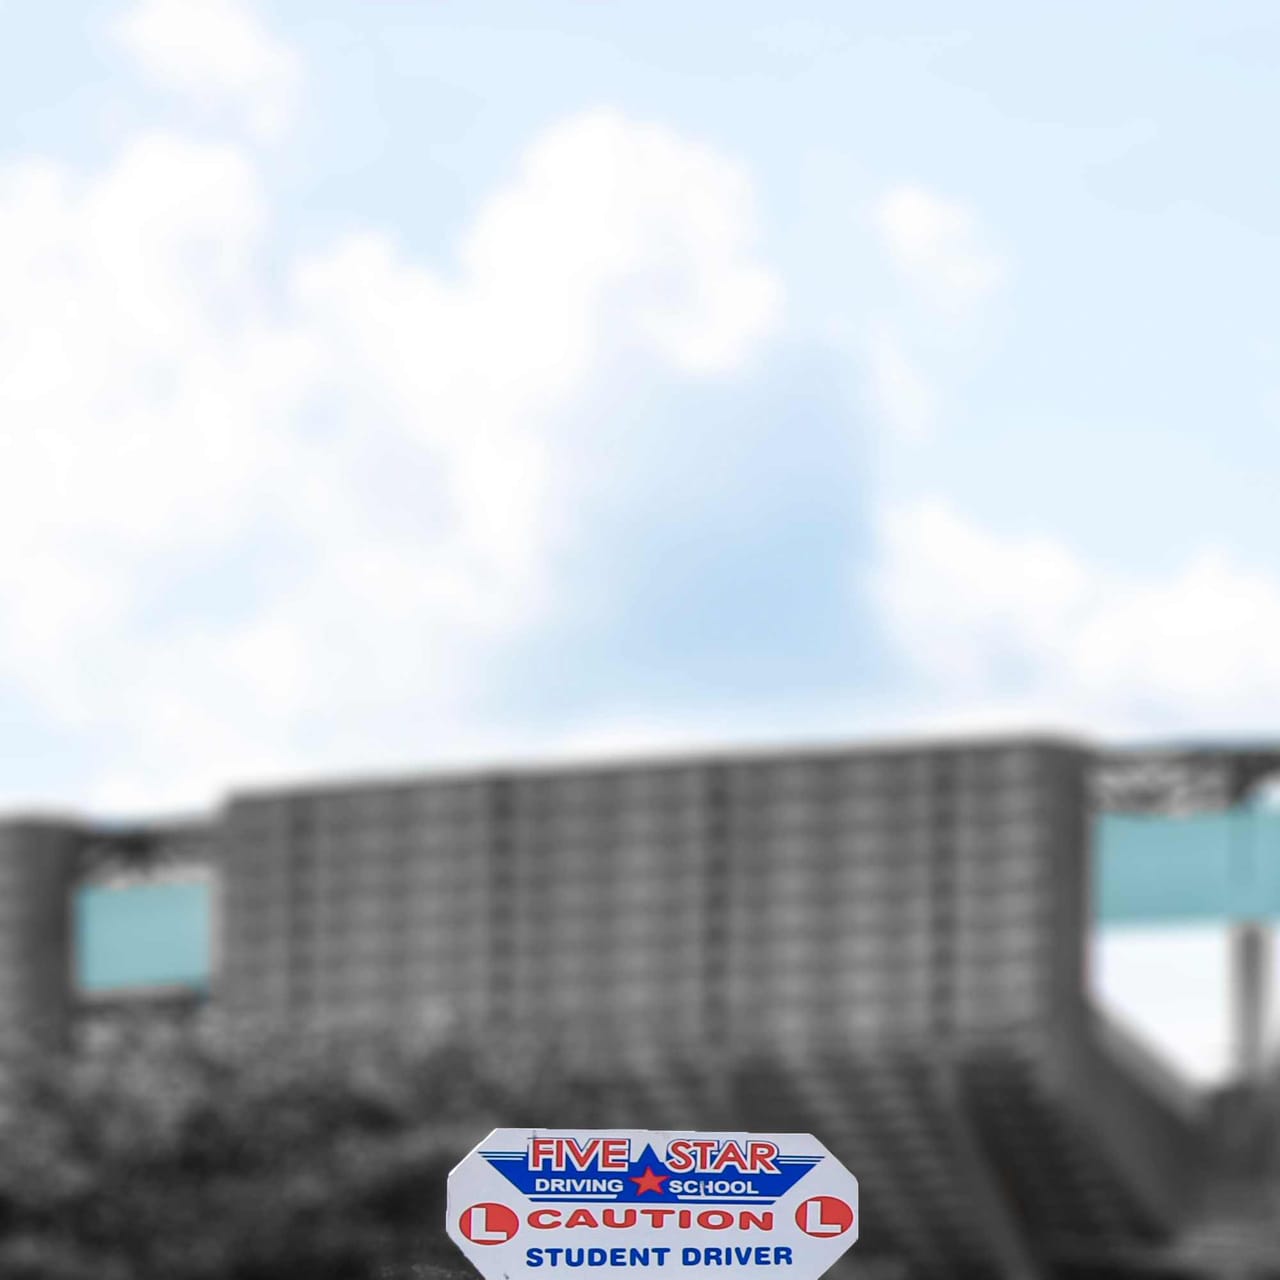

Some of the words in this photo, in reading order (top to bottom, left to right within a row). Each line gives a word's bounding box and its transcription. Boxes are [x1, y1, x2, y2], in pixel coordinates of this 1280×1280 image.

[528, 1138, 630, 1172] FIVE
[664, 1139, 782, 1174] STAR
[535, 1178, 624, 1193] DRIVING
[669, 1180, 759, 1195] SCHOOL
[470, 1207, 507, 1241] L
[527, 1209, 773, 1230] CAUTION
[806, 1201, 842, 1234] L
[526, 1247, 671, 1267] STUDENT
[682, 1246, 792, 1266] DRIVER
